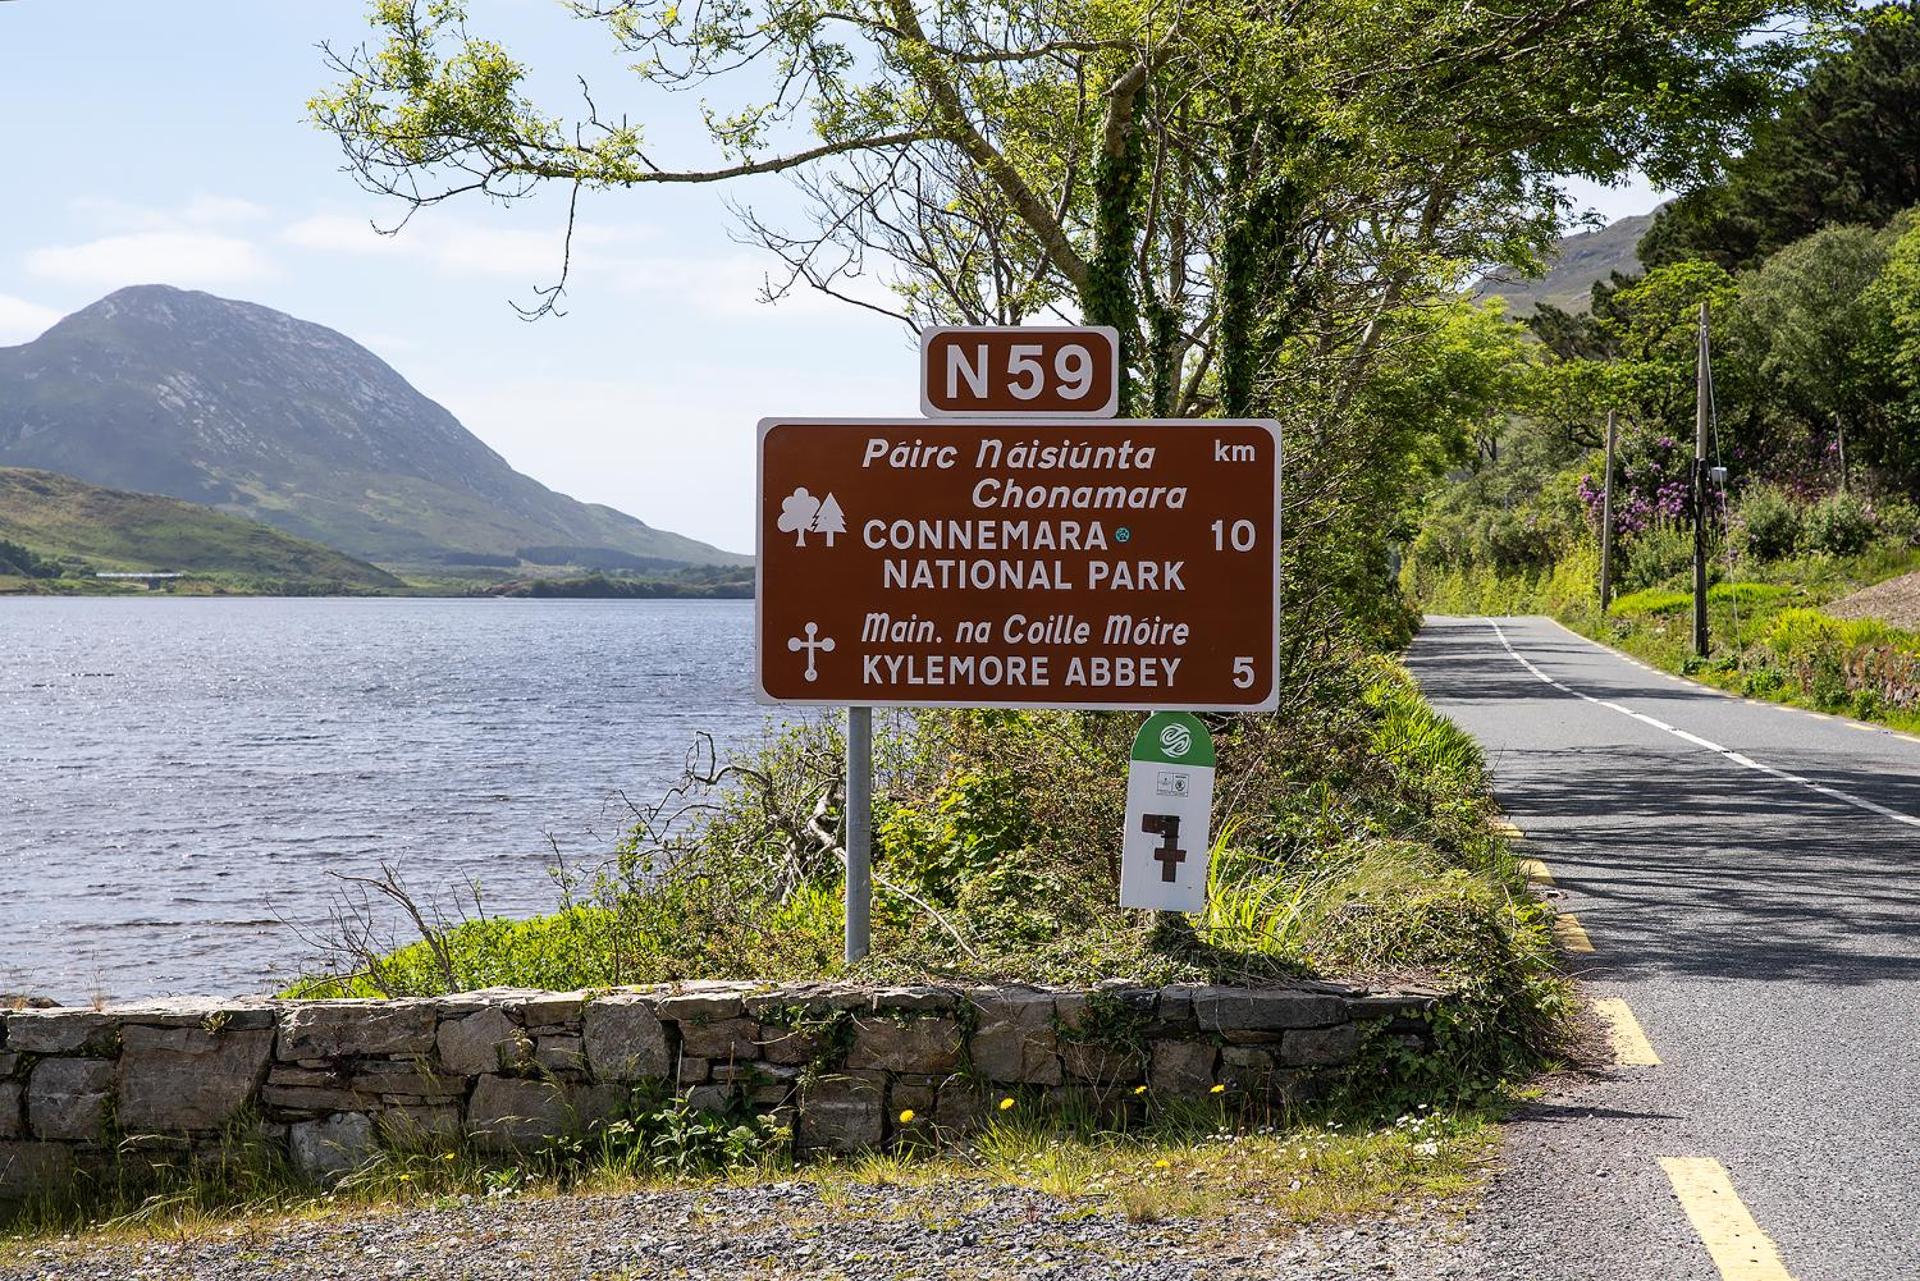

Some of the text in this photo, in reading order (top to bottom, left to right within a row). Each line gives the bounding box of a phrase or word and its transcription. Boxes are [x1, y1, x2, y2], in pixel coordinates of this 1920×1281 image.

[863, 439, 1155, 469] Páirc Náisiúnta
[1215, 440, 1255, 461] km
[973, 478, 1187, 508] Chonamara
[864, 520, 1107, 550] CONNEMARA
[1212, 520, 1255, 551] 10
[884, 560, 1185, 590] NATIONAL PARK
[862, 613, 1189, 645] Main. na Coille Móire
[864, 655, 1181, 686] KYLEMORE ABBEY
[1233, 657, 1254, 688] 5
